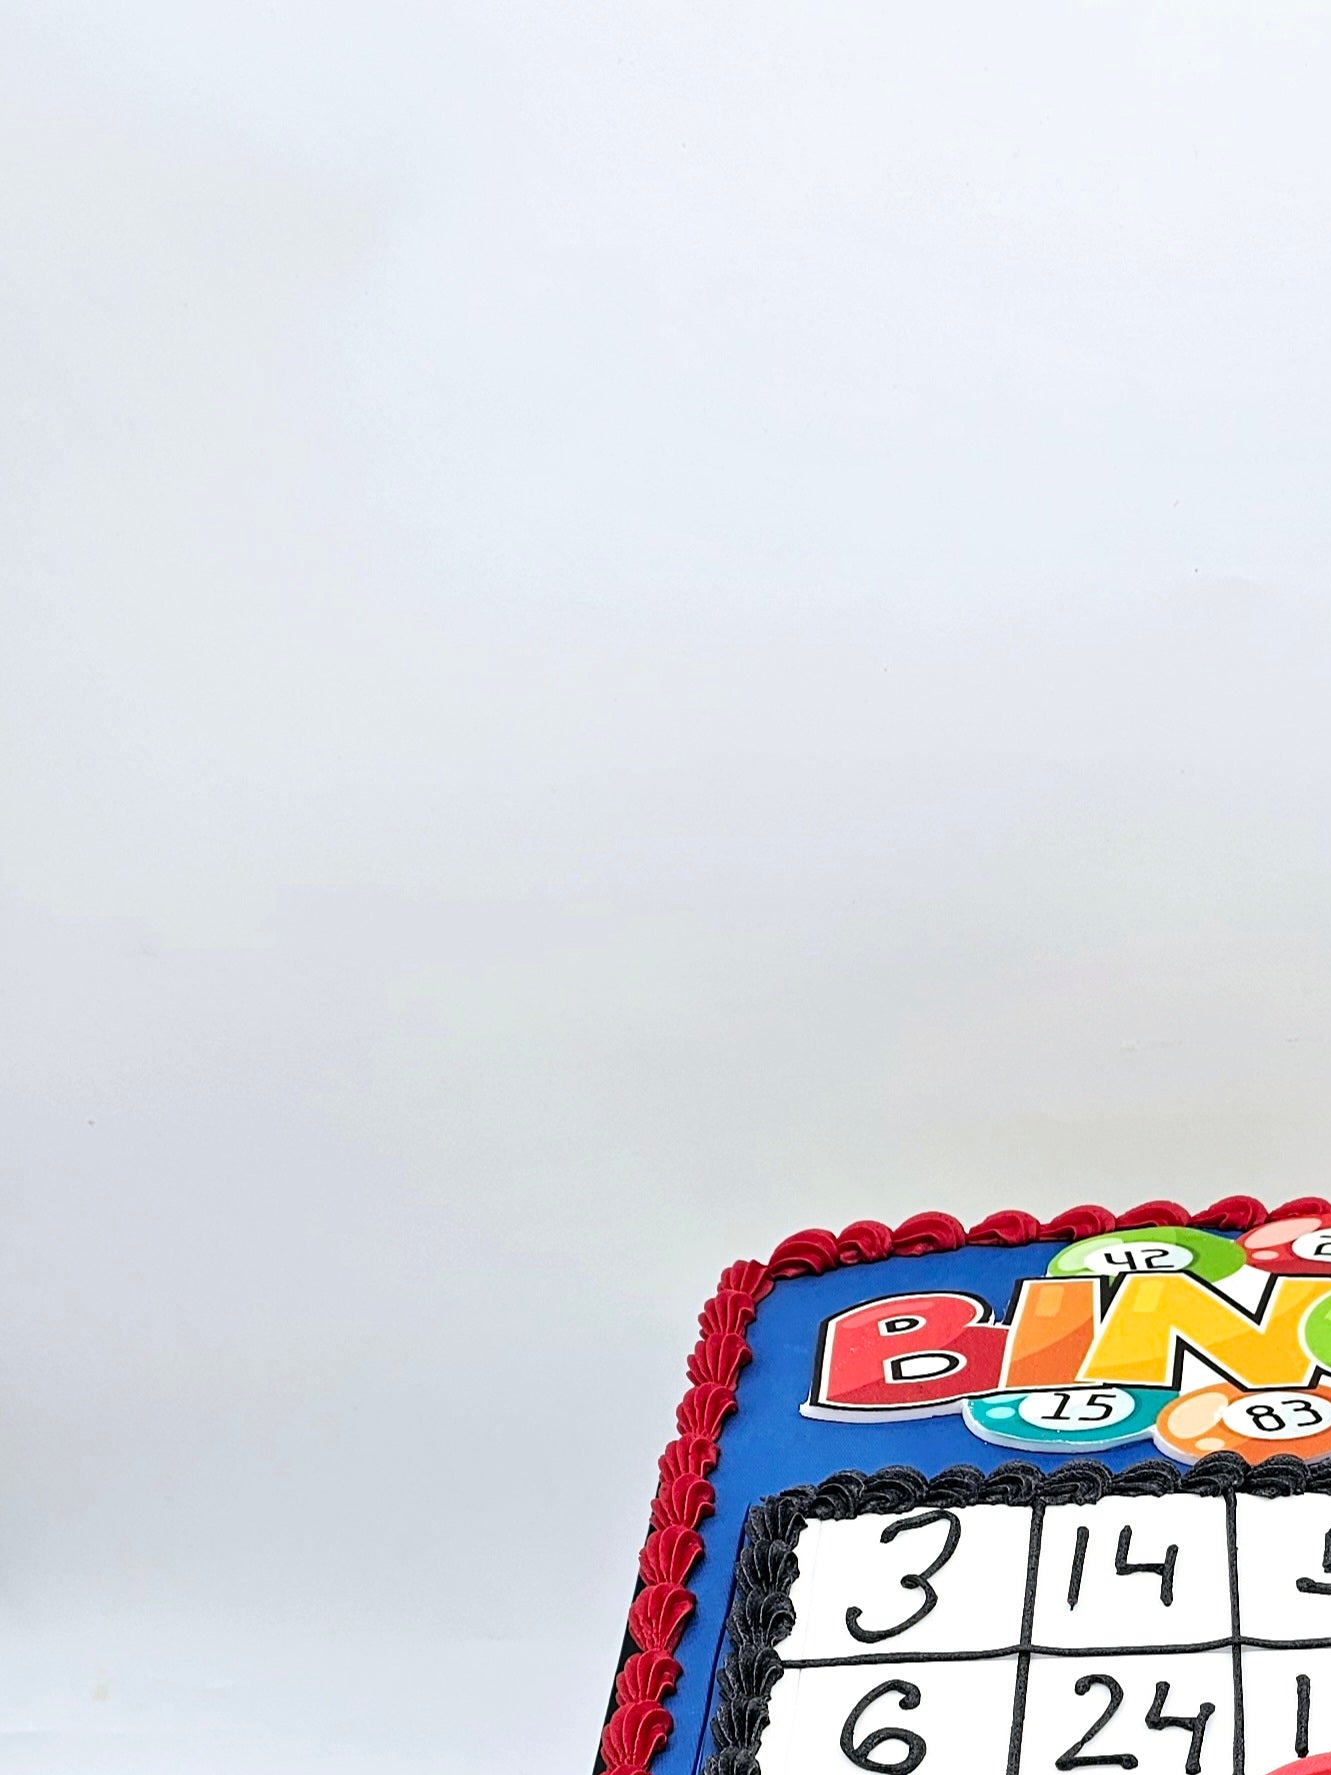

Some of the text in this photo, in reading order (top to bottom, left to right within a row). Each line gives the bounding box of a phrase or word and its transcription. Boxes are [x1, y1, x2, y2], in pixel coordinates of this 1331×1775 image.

[1104, 1249, 1175, 1270] 42
[1041, 1392, 1117, 1421] 15
[1246, 1400, 1322, 1431] 83
[845, 1510, 961, 1643] 3
[1068, 1525, 1178, 1610] 14
[840, 1680, 926, 1775] 6
[1055, 1675, 1215, 1775] 24
